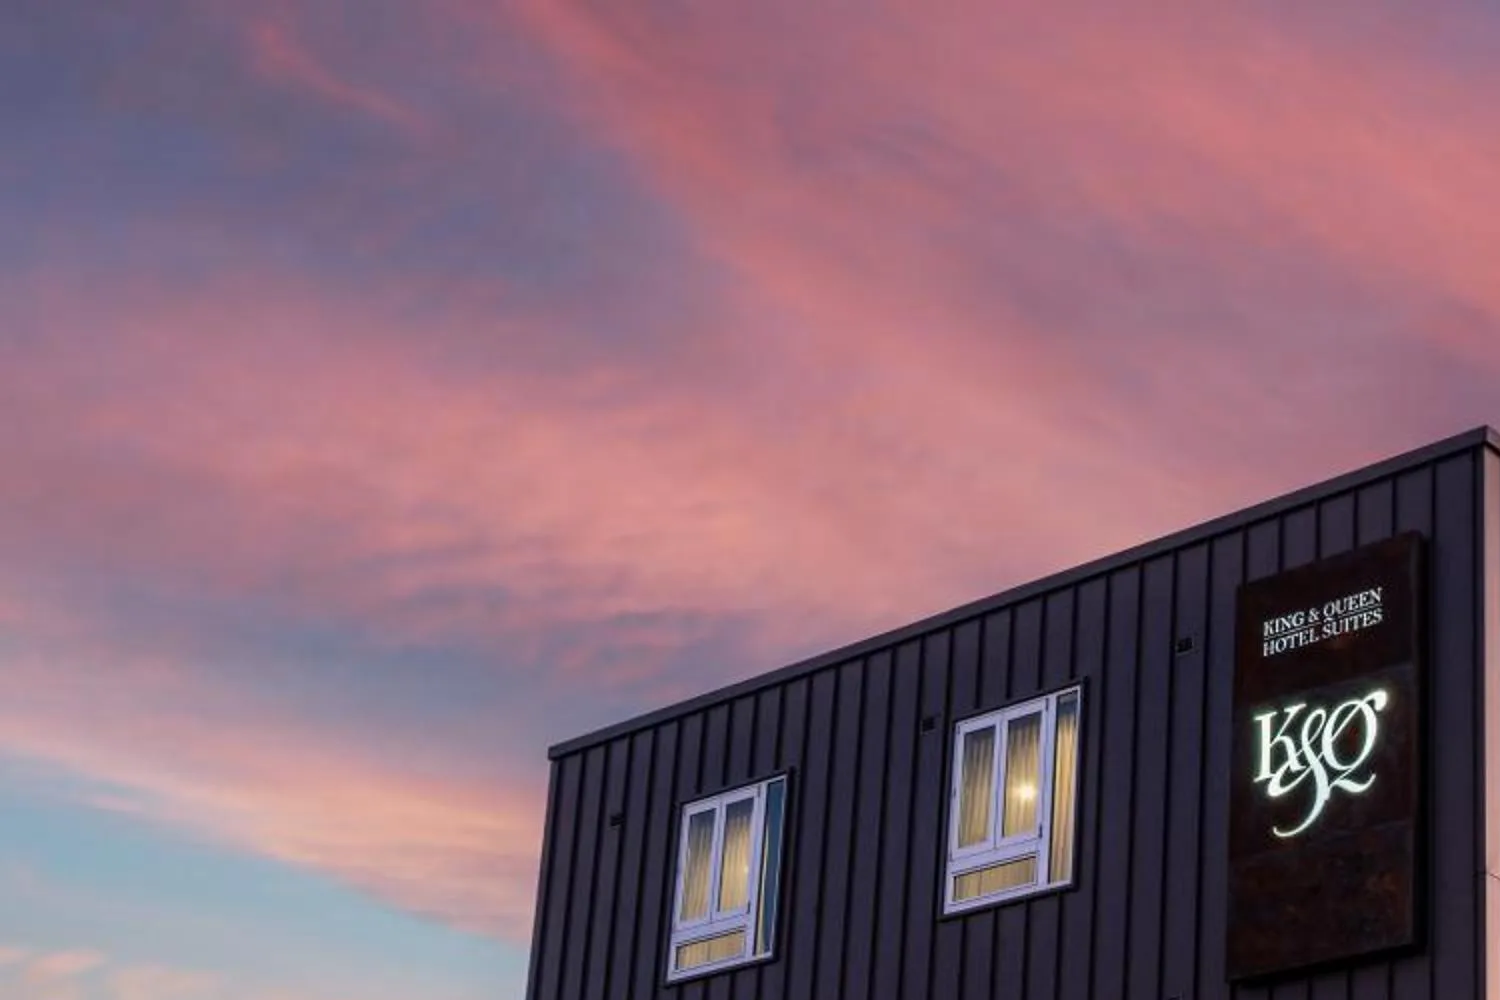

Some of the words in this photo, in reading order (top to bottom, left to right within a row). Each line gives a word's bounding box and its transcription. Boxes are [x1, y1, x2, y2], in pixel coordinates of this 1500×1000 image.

[1263, 611, 1305, 637] KING
[1308, 608, 1320, 623] &
[1323, 587, 1382, 622] QUEEN
[1263, 628, 1319, 657] HOTEL
[1322, 608, 1382, 639] SUITES
